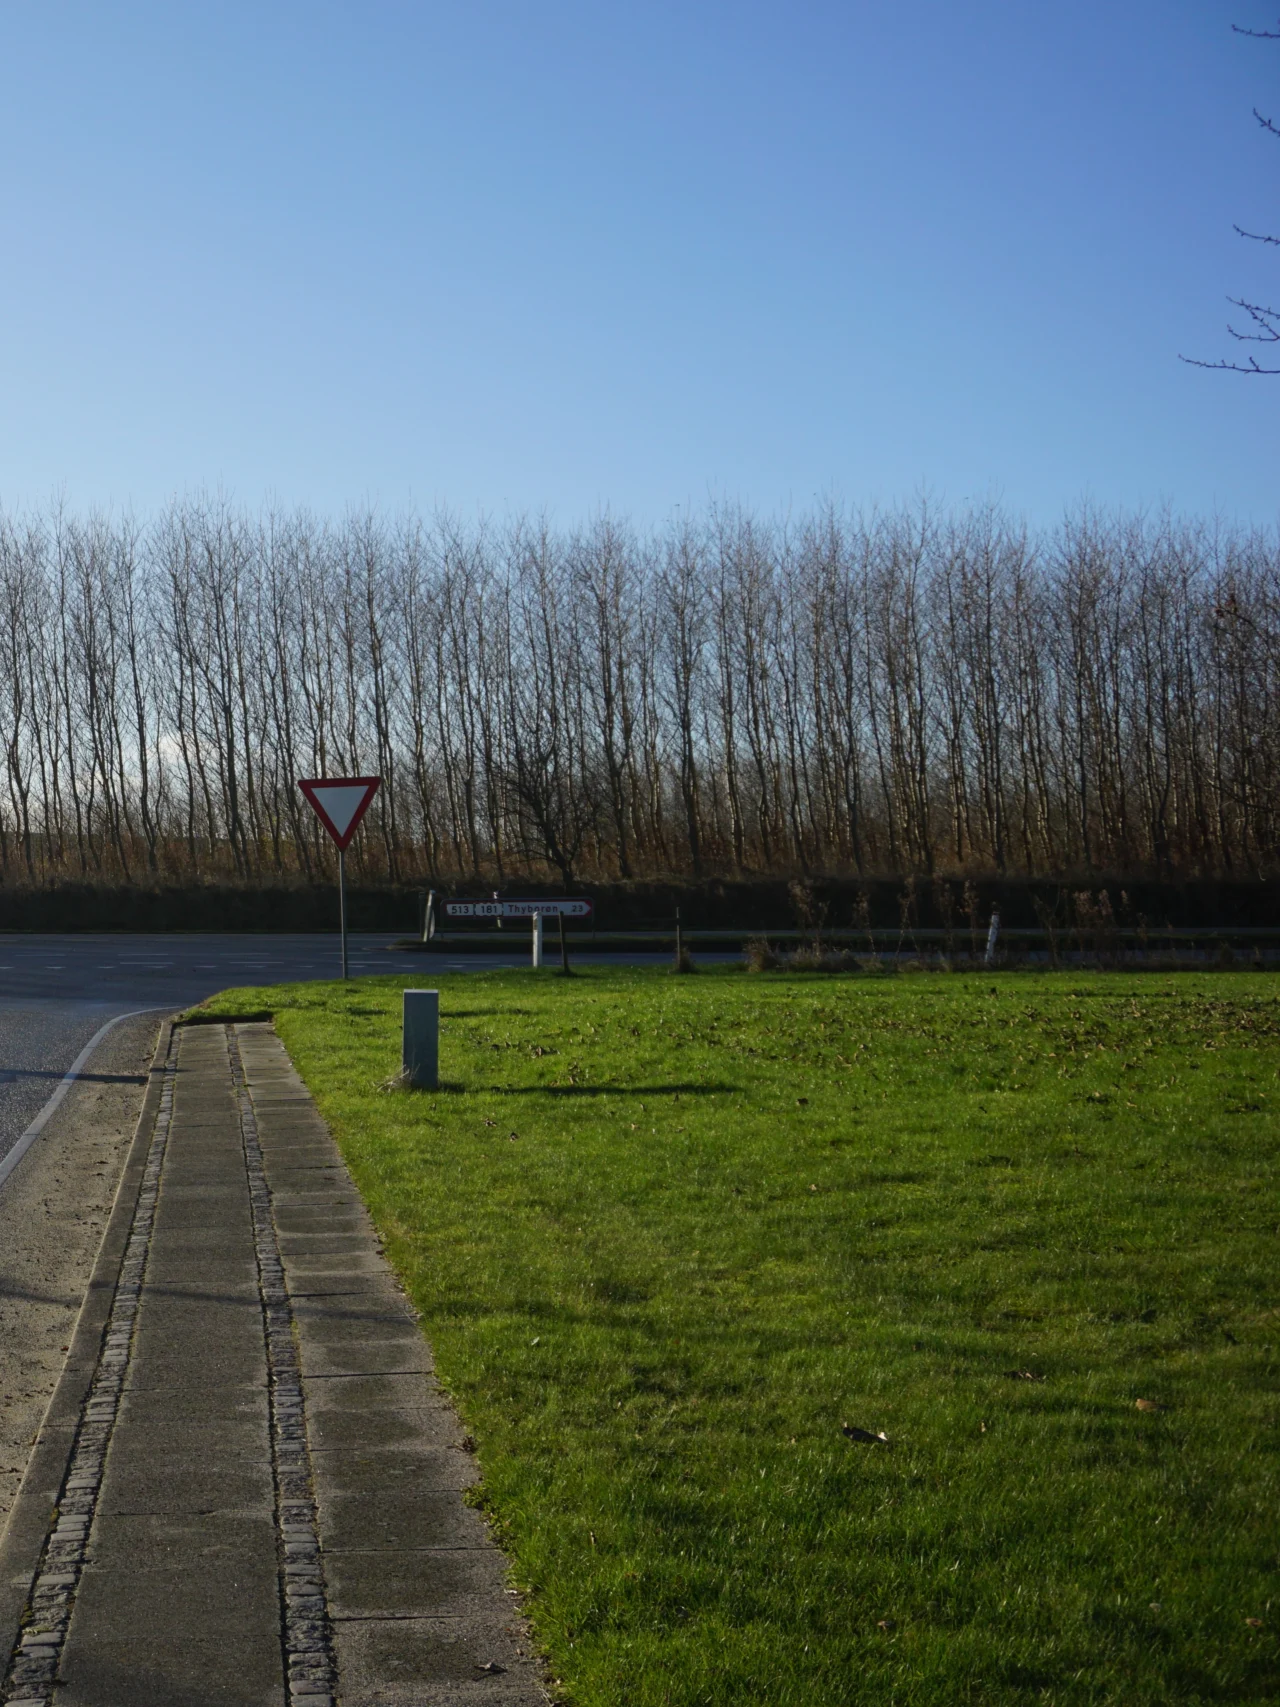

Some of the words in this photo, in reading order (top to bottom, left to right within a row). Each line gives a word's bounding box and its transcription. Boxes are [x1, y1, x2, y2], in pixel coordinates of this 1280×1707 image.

[451, 905, 469, 914] 513
[481, 905, 497, 914] 181
[508, 904, 558, 914] Thyborøn
[571, 904, 584, 913] 23
